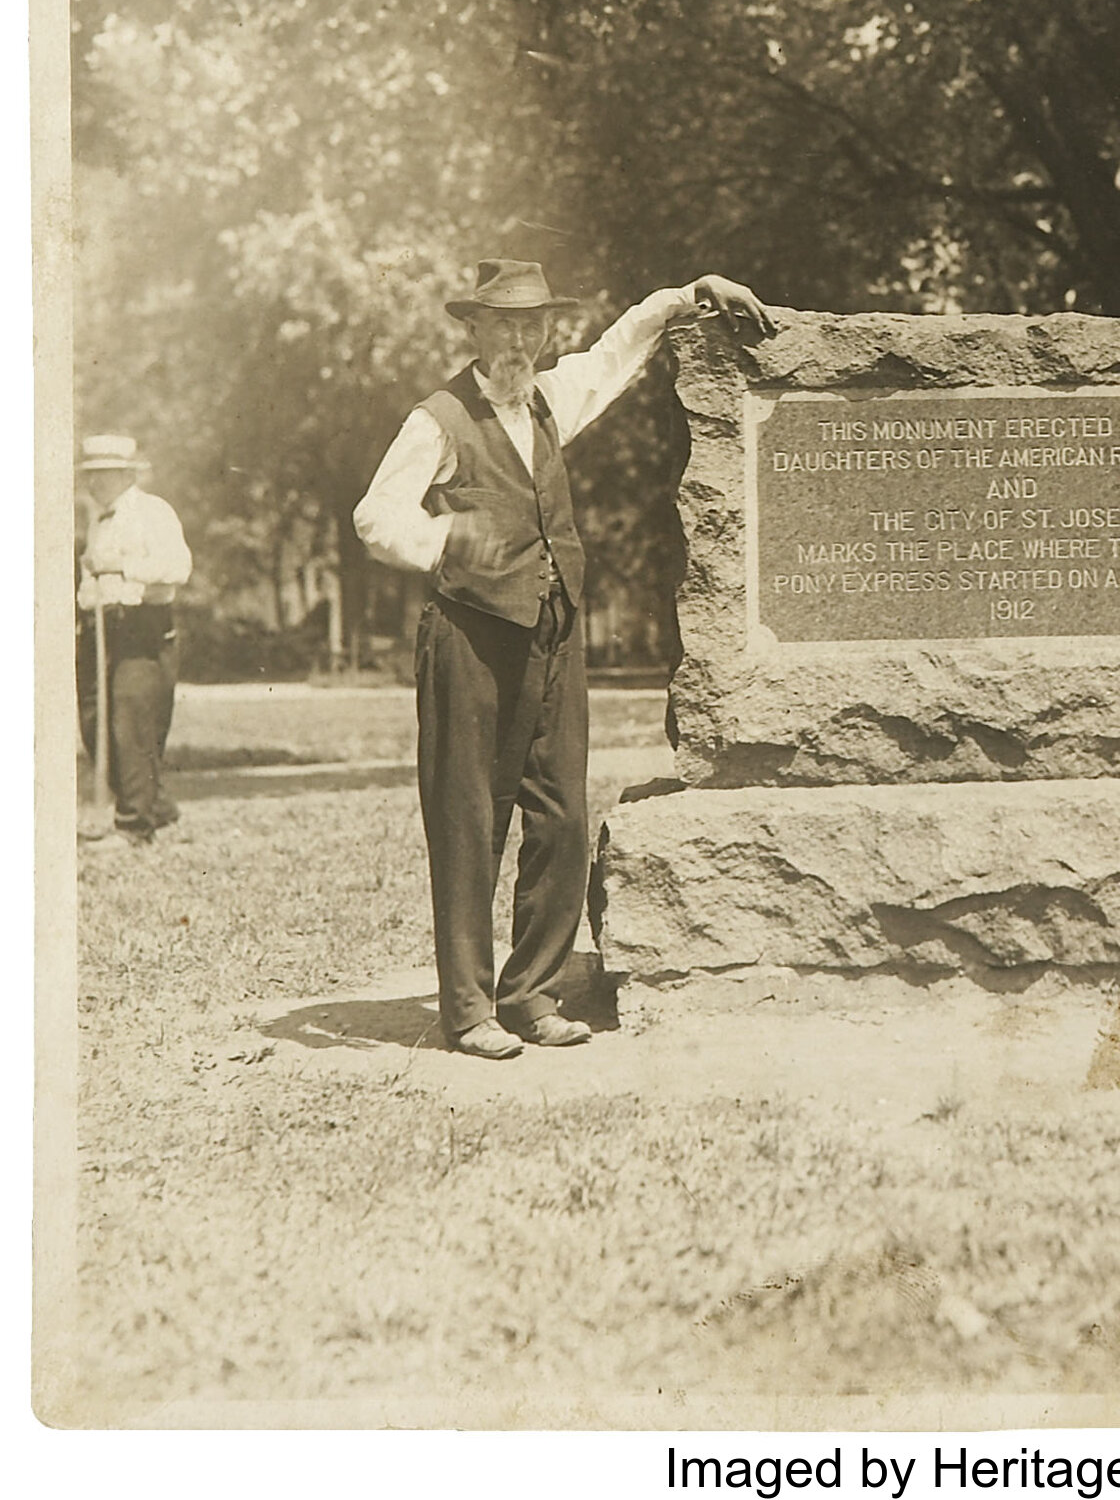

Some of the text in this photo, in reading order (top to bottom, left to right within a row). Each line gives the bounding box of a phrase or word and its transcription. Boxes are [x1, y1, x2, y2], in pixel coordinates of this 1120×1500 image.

[818, 420, 867, 441] THIS
[873, 419, 997, 440] MONUMENT
[1006, 417, 1112, 438] ERECTED
[773, 450, 911, 472] DAUGHTERS
[916, 449, 945, 469] OF
[951, 448, 993, 468] THE
[999, 446, 1104, 467] AMERICAN
[986, 477, 1038, 499] AND
[869, 511, 915, 531] THE
[924, 510, 975, 531] CITY
[983, 509, 1013, 530] OF
[1021, 508, 1055, 529] ST.
[798, 542, 877, 563] MARKS
[886, 541, 930, 561] THE
[936, 539, 1014, 561] PLACE
[1022, 538, 1100, 559] WHERE
[774, 573, 836, 594] PONY
[843, 571, 951, 593] EXPRESS
[958, 569, 1062, 590] STARTED
[1068, 569, 1098, 589] ON
[990, 599, 1035, 620] 1912
